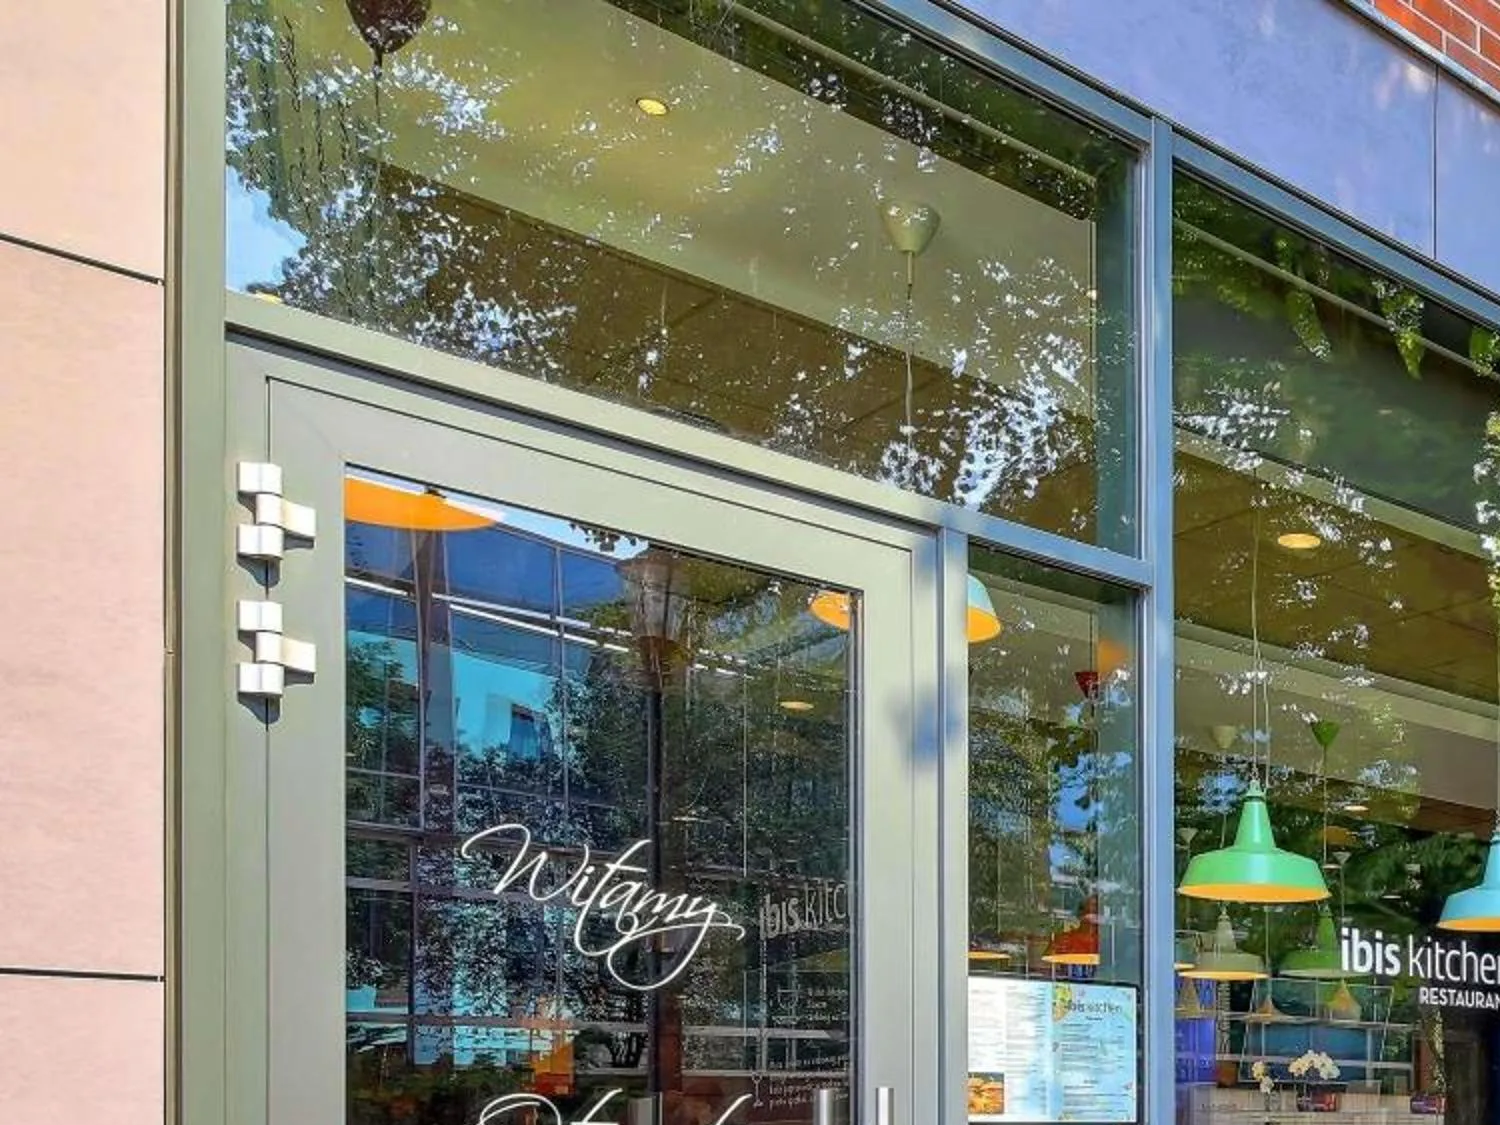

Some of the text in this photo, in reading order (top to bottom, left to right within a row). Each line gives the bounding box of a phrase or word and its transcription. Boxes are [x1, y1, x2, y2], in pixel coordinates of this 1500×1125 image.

[461, 822, 746, 991] Witamy
[803, 879, 850, 928] kitc
[1341, 926, 1401, 977] ibis
